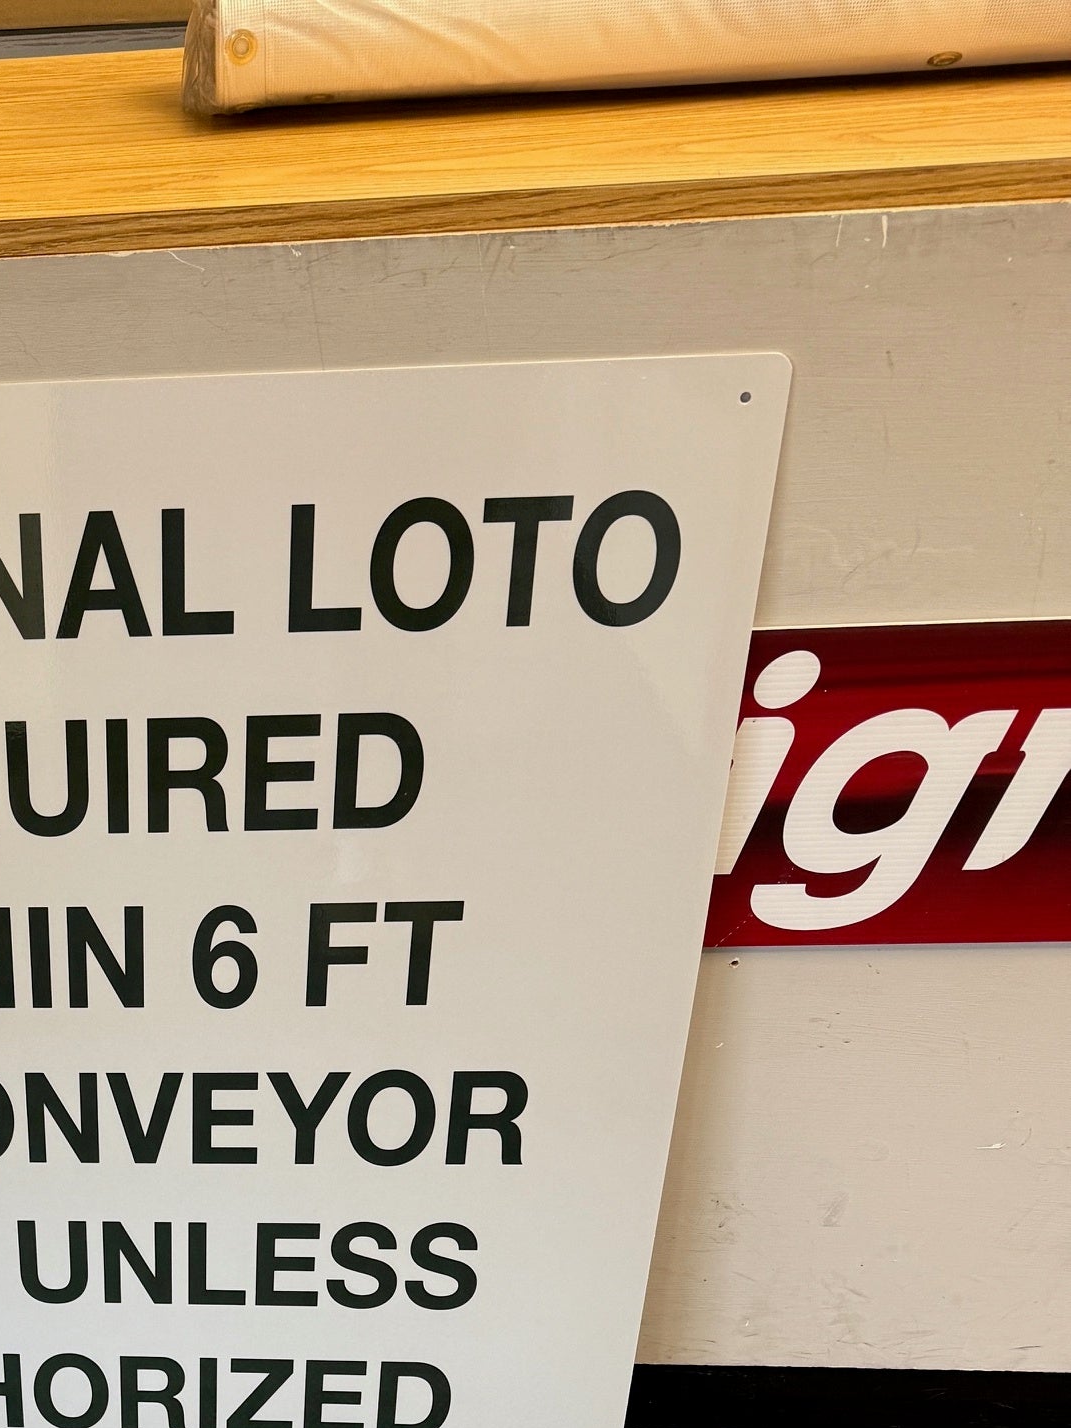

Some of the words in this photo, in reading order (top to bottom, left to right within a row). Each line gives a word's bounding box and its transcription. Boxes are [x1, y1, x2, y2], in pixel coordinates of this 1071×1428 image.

[288, 489, 682, 637] LOTO
[192, 904, 259, 1010] 6
[305, 900, 465, 1008] FT
[16, 1219, 478, 1311] UNLESS
